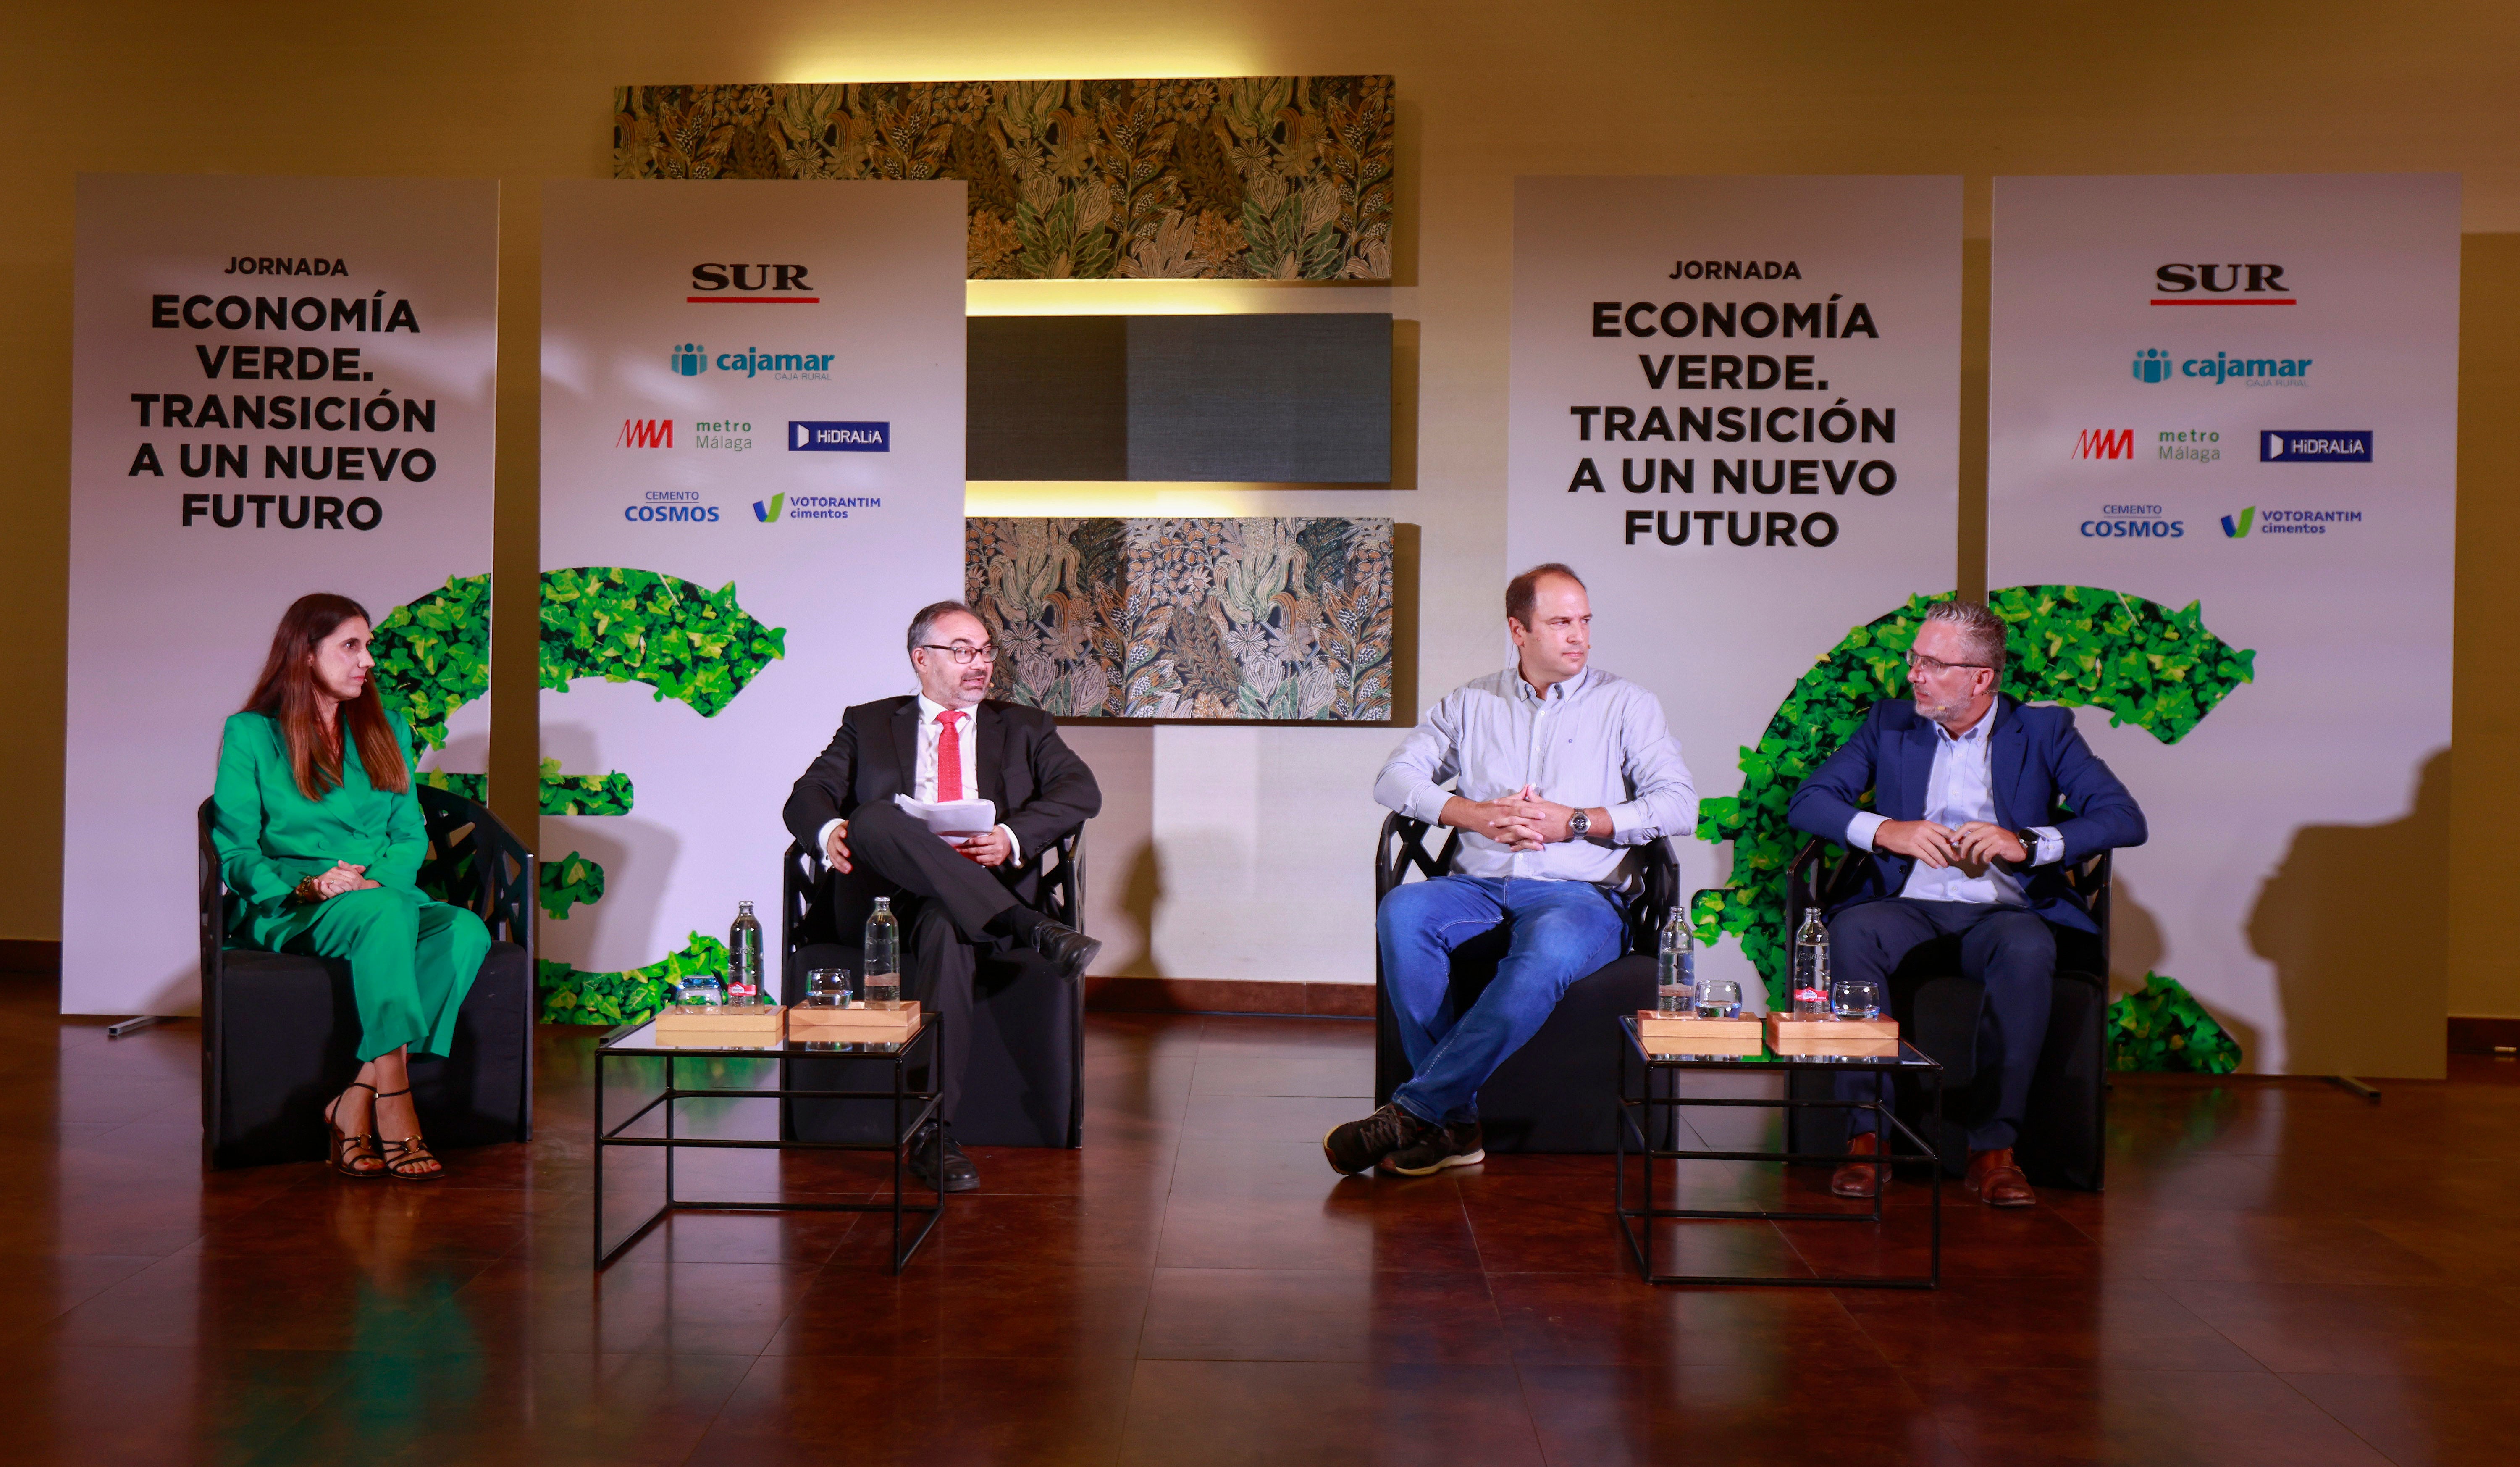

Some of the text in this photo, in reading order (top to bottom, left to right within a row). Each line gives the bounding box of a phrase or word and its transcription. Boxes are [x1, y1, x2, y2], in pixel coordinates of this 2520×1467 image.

[224, 256, 349, 276] JORNADA
[1669, 260, 1802, 280] JORNADA
[692, 263, 813, 291] SUR
[2156, 263, 2289, 293] SUR
[152, 289, 420, 333] ECONOMÍA
[1593, 293, 1879, 338] ECONOMÍA
[195, 344, 373, 381] VERDE.
[717, 347, 835, 378] cajamar
[1638, 354, 1828, 390] VERDE.
[2182, 351, 2312, 385] cajamar
[2276, 379, 2309, 387] RURAL
[131, 388, 435, 432] TRANSICIÓN
[1570, 397, 1895, 443] TRANSICIÓN
[696, 419, 751, 432] metro
[2159, 429, 2219, 442] metro
[696, 435, 751, 452] Málaga
[128, 443, 436, 482] A UN NUEVO
[2159, 446, 2220, 463] Málaga
[1568, 457, 1896, 496] A UN NUEVO
[645, 491, 699, 500] CEMENTO
[790, 497, 880, 507] VOTORANTIM
[182, 493, 382, 531] FUTURO
[625, 506, 719, 522] COSMOS
[790, 508, 848, 518] cimentos
[2103, 505, 2162, 514] CEMENTO
[2262, 511, 2362, 521] VOTORANTIM
[1625, 510, 1839, 547] FUTURO
[2080, 521, 2184, 537] COSMOS
[2262, 520, 2326, 534] cimentos
